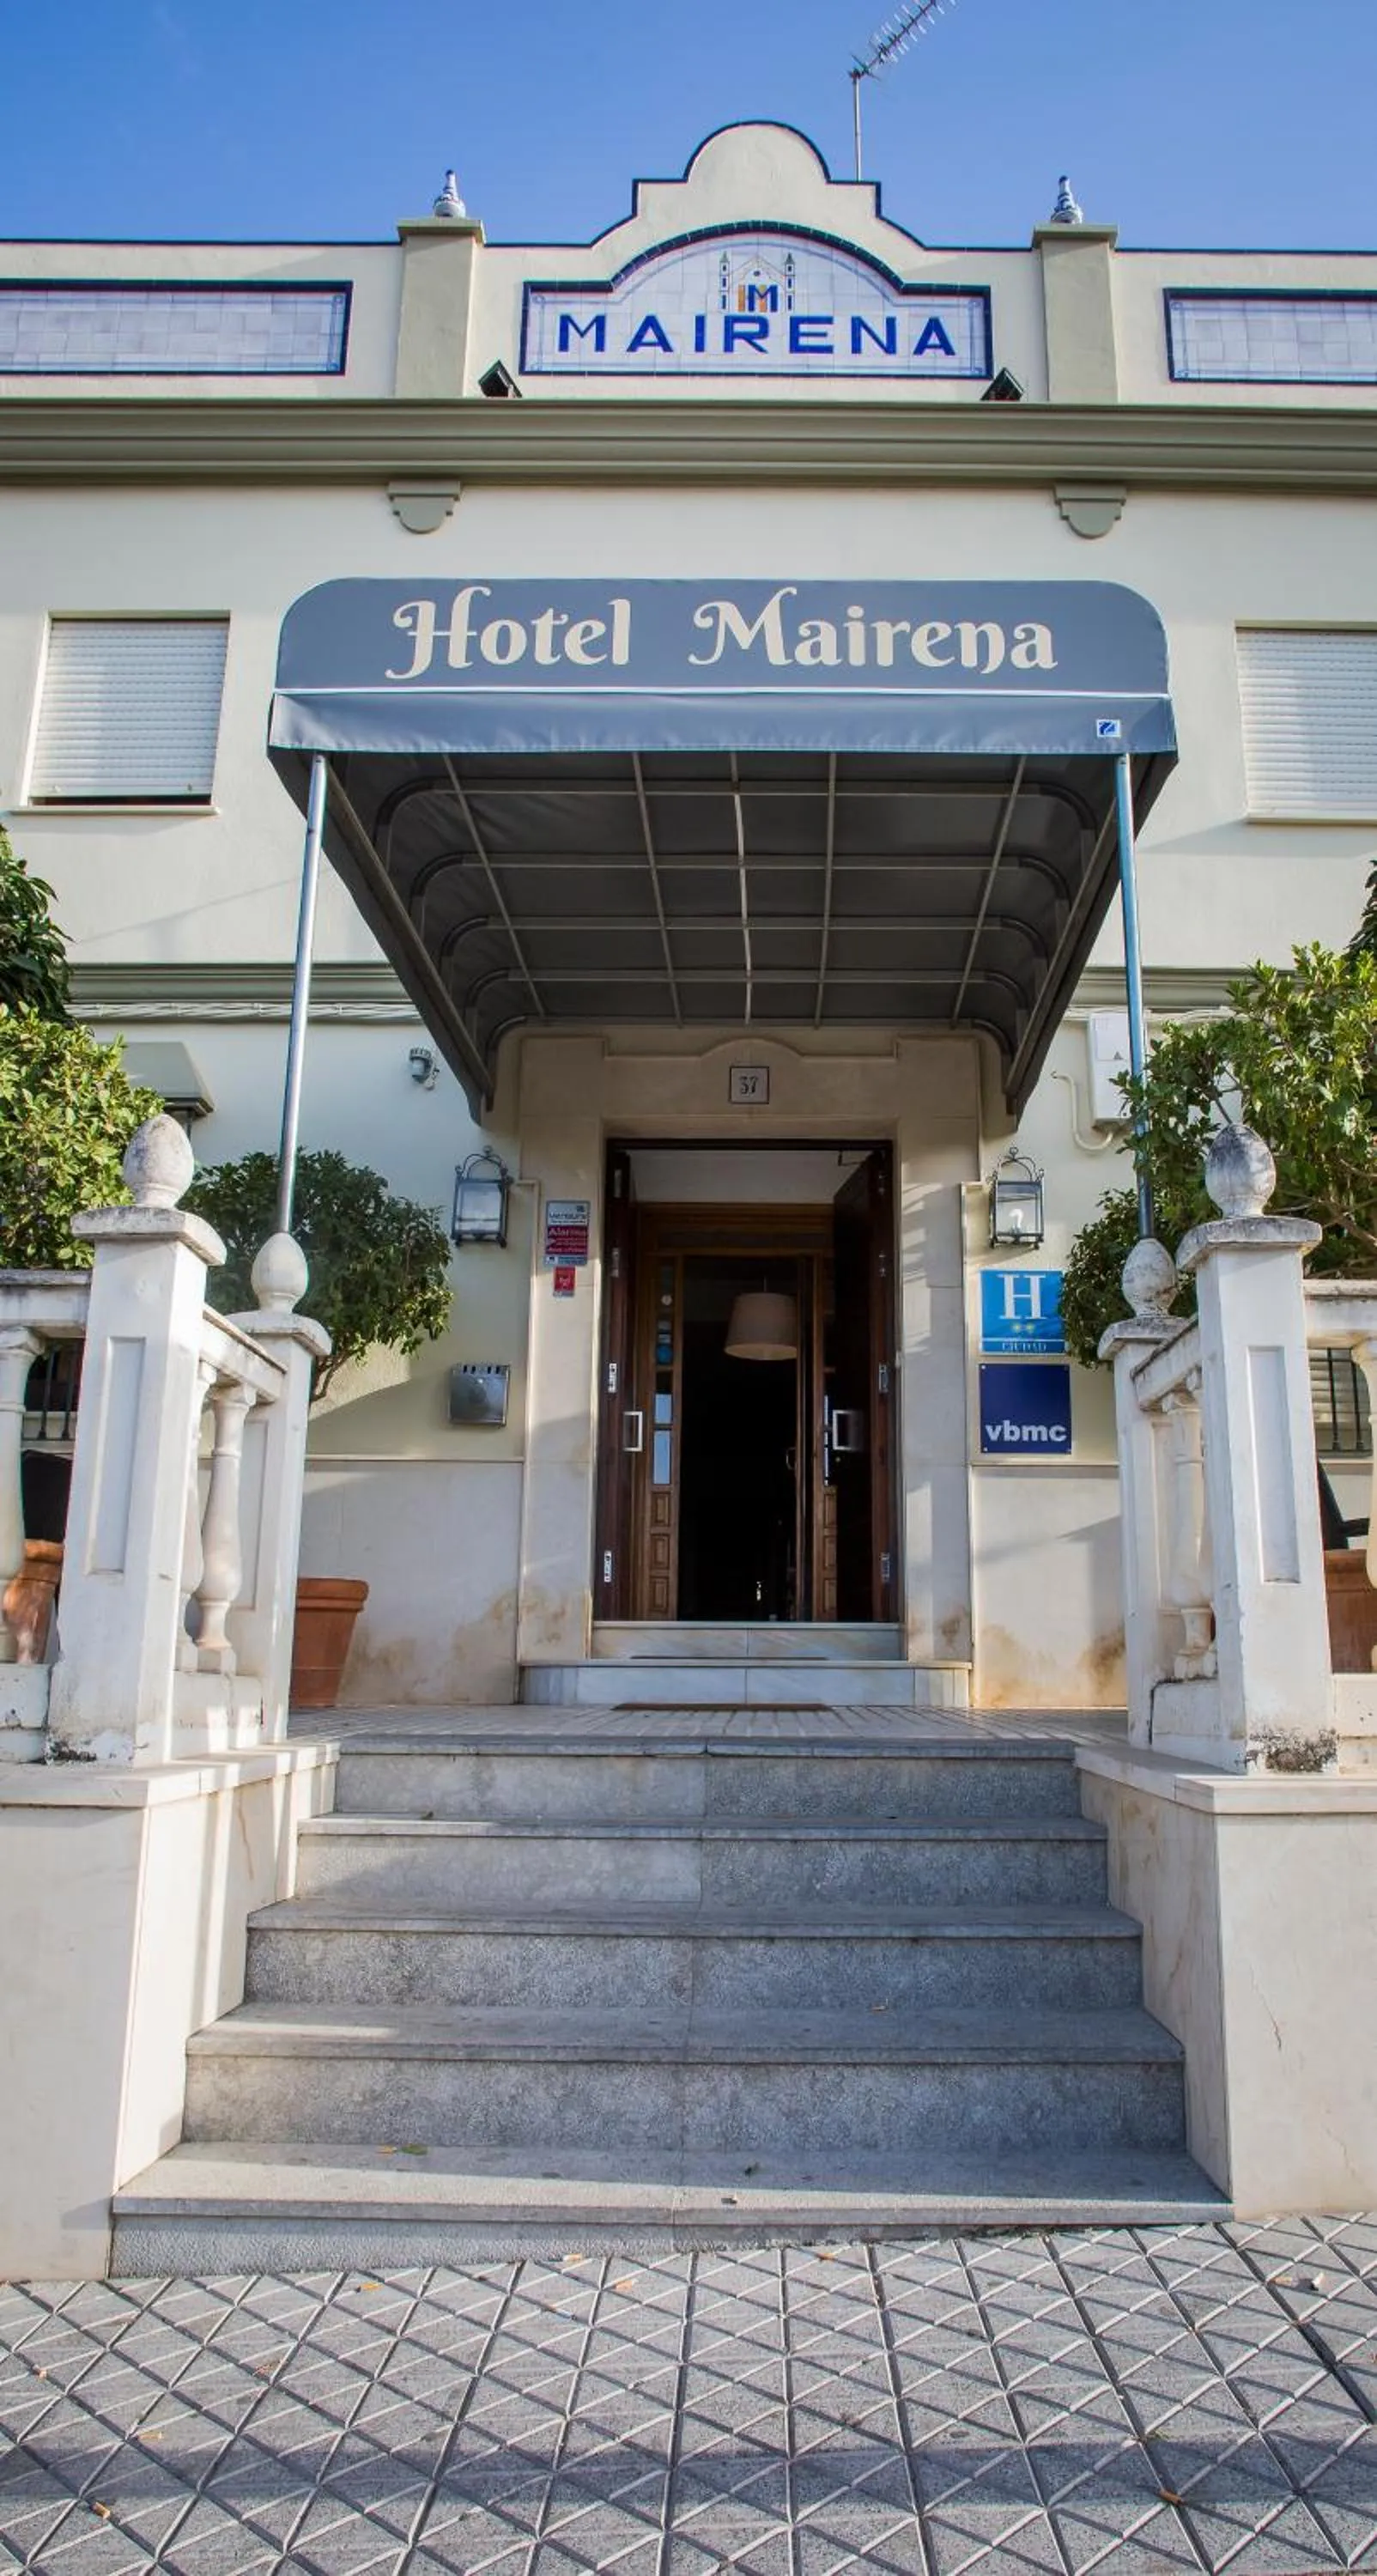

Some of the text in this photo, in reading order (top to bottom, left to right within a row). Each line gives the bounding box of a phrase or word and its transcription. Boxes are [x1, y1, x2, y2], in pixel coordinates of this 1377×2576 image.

[557, 313, 956, 356] MAIRENA
[385, 586, 1059, 679] Hotel Mairena
[997, 1274, 1047, 1320] H
[985, 1419, 1067, 1442] vbmc
